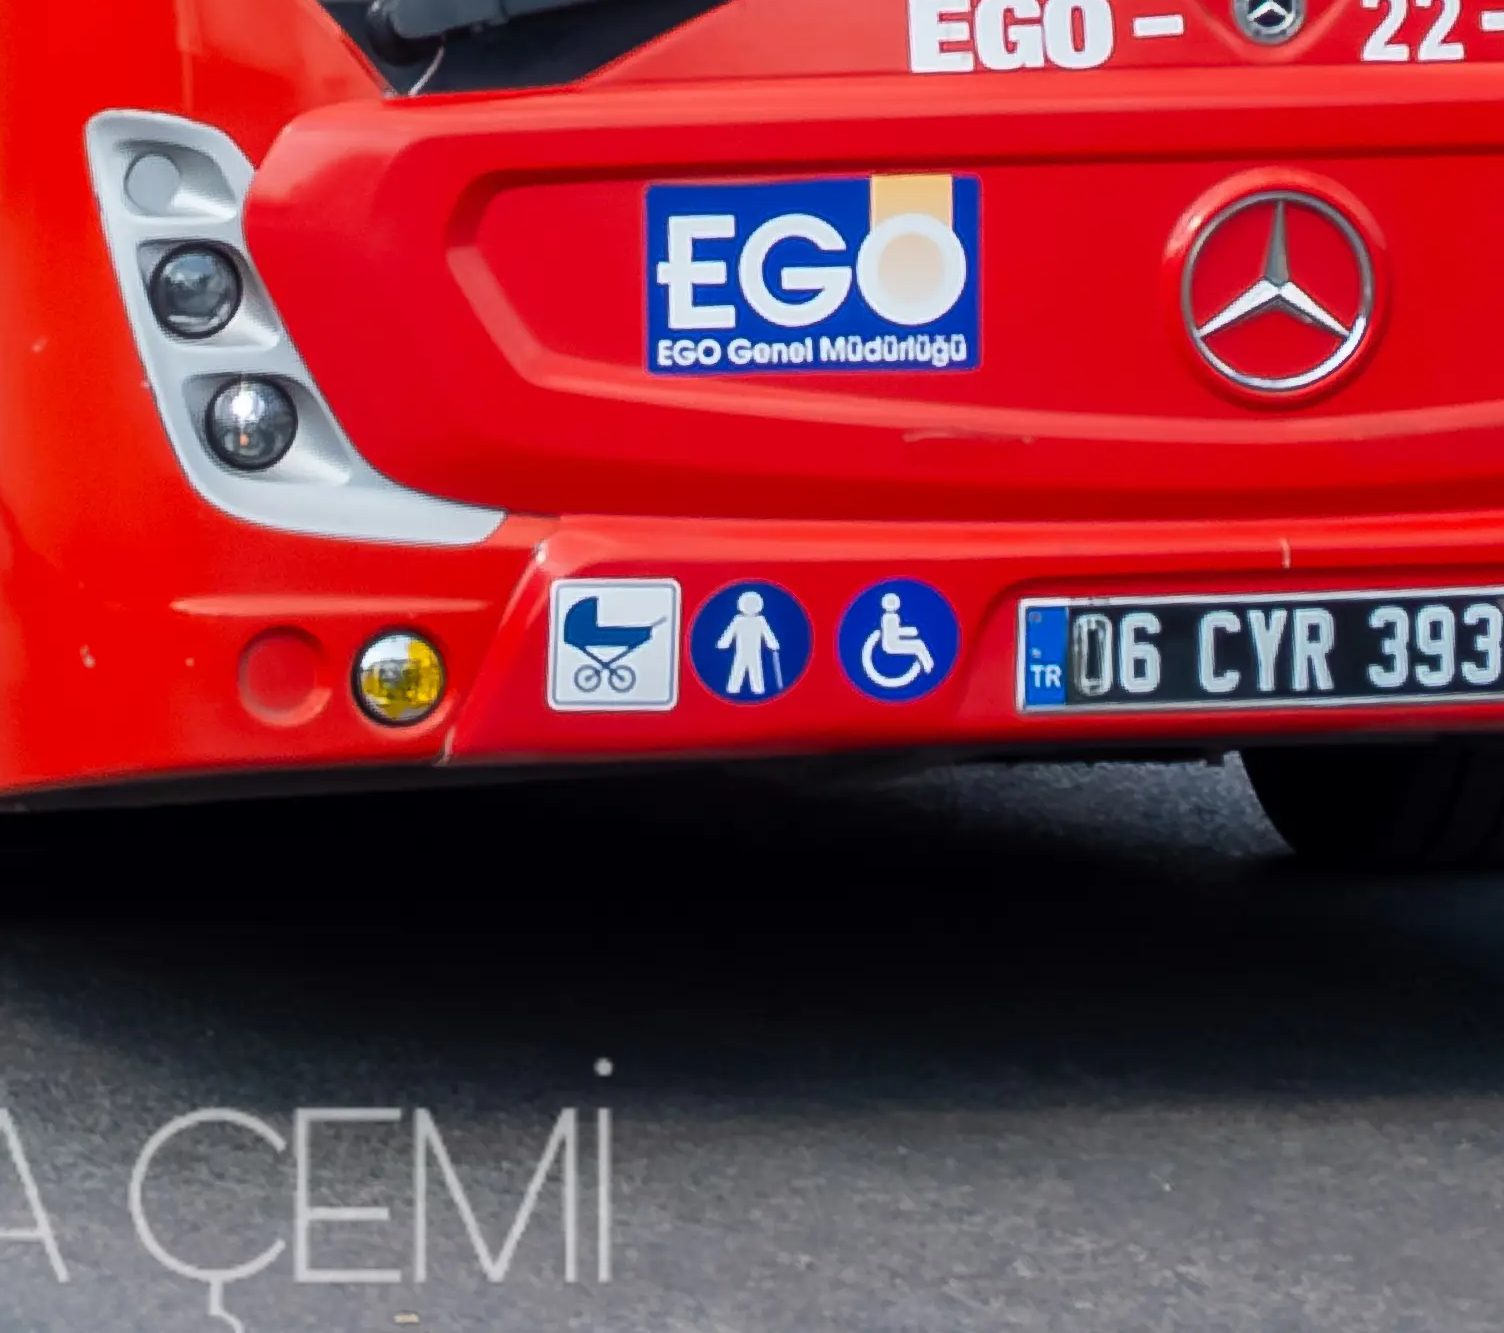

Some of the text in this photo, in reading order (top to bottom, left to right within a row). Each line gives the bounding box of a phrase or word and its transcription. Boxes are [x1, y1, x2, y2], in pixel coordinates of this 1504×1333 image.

[656, 213, 967, 329] EGO
[657, 338, 722, 366] EGO
[1030, 664, 1063, 689] TR
[1072, 603, 1503, 696] 06 CYR 393
